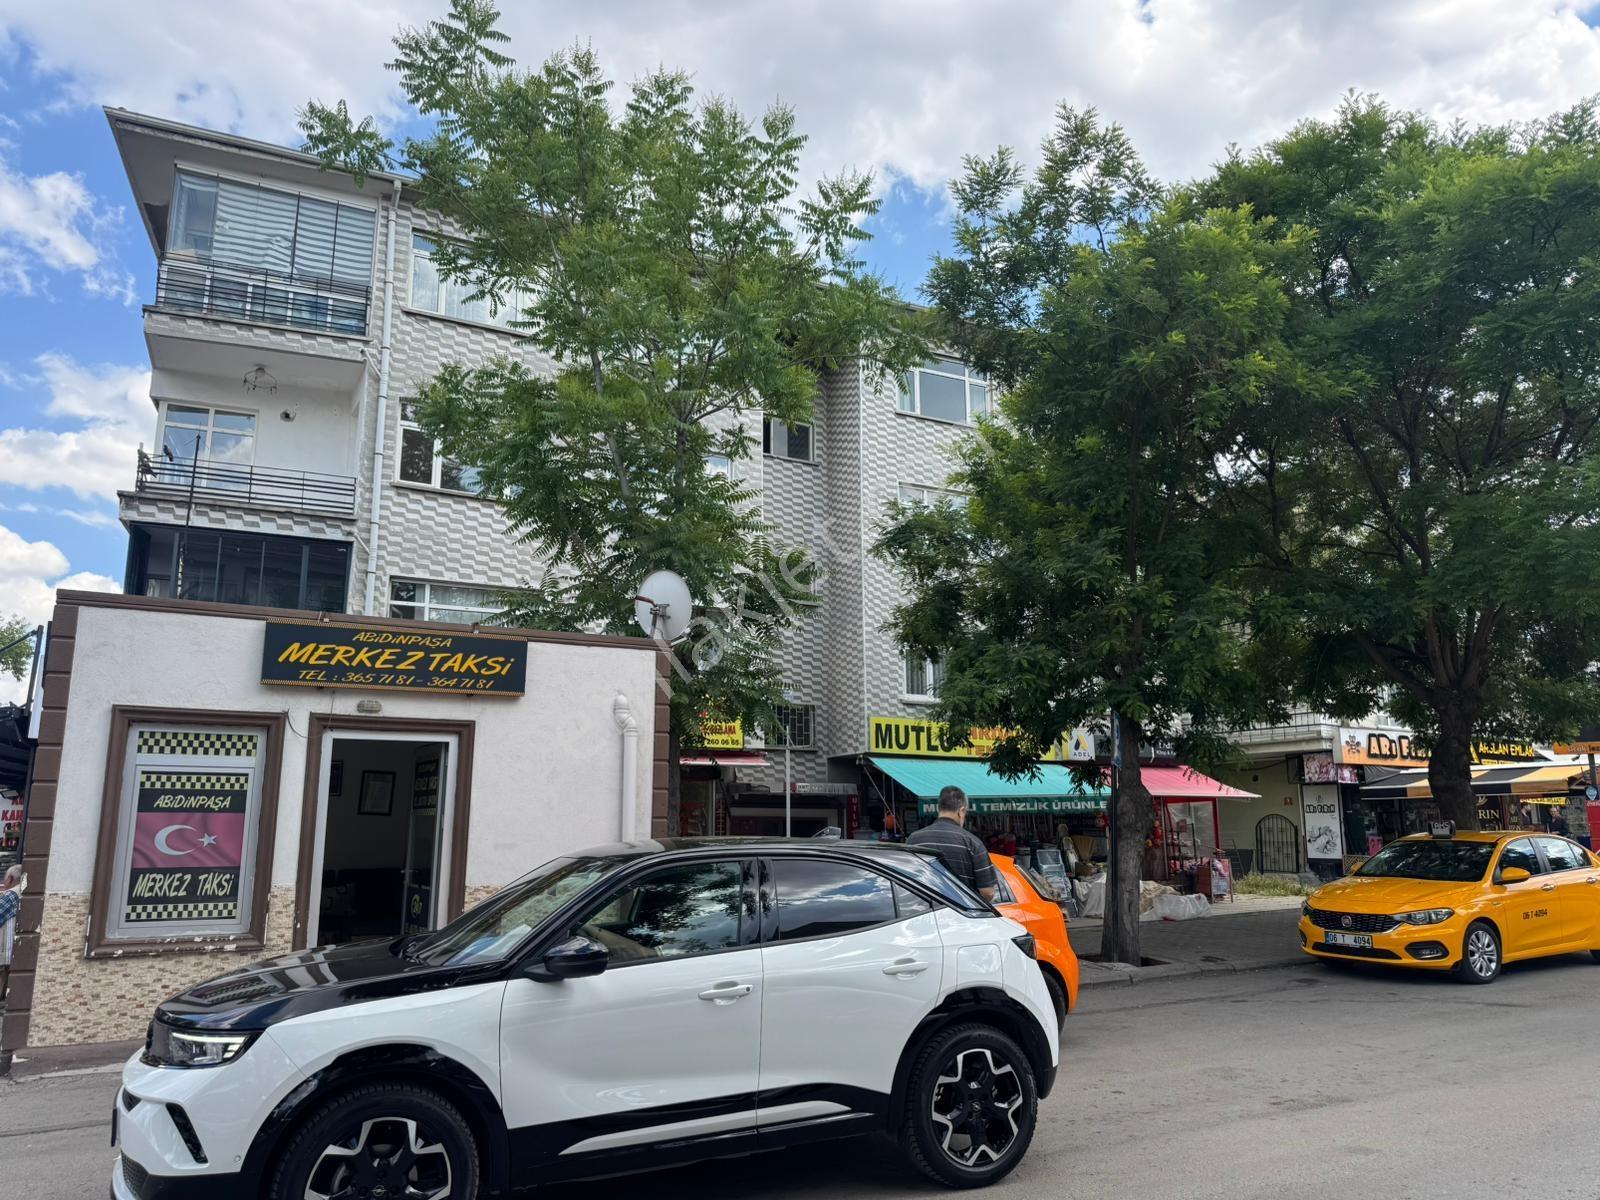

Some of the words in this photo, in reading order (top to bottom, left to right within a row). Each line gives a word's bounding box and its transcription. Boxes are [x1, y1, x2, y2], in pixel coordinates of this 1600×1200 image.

[278, 642, 425, 670] MERKEZ
[298, 670, 328, 681] TEL
[342, 673, 376, 683] 365
[427, 677, 458, 687] 364
[981, 800, 1048, 812] TEMİZLİK
[132, 872, 192, 897] MERKEZ
[1329, 933, 1338, 942] 06
[1353, 936, 1371, 945] 4094
